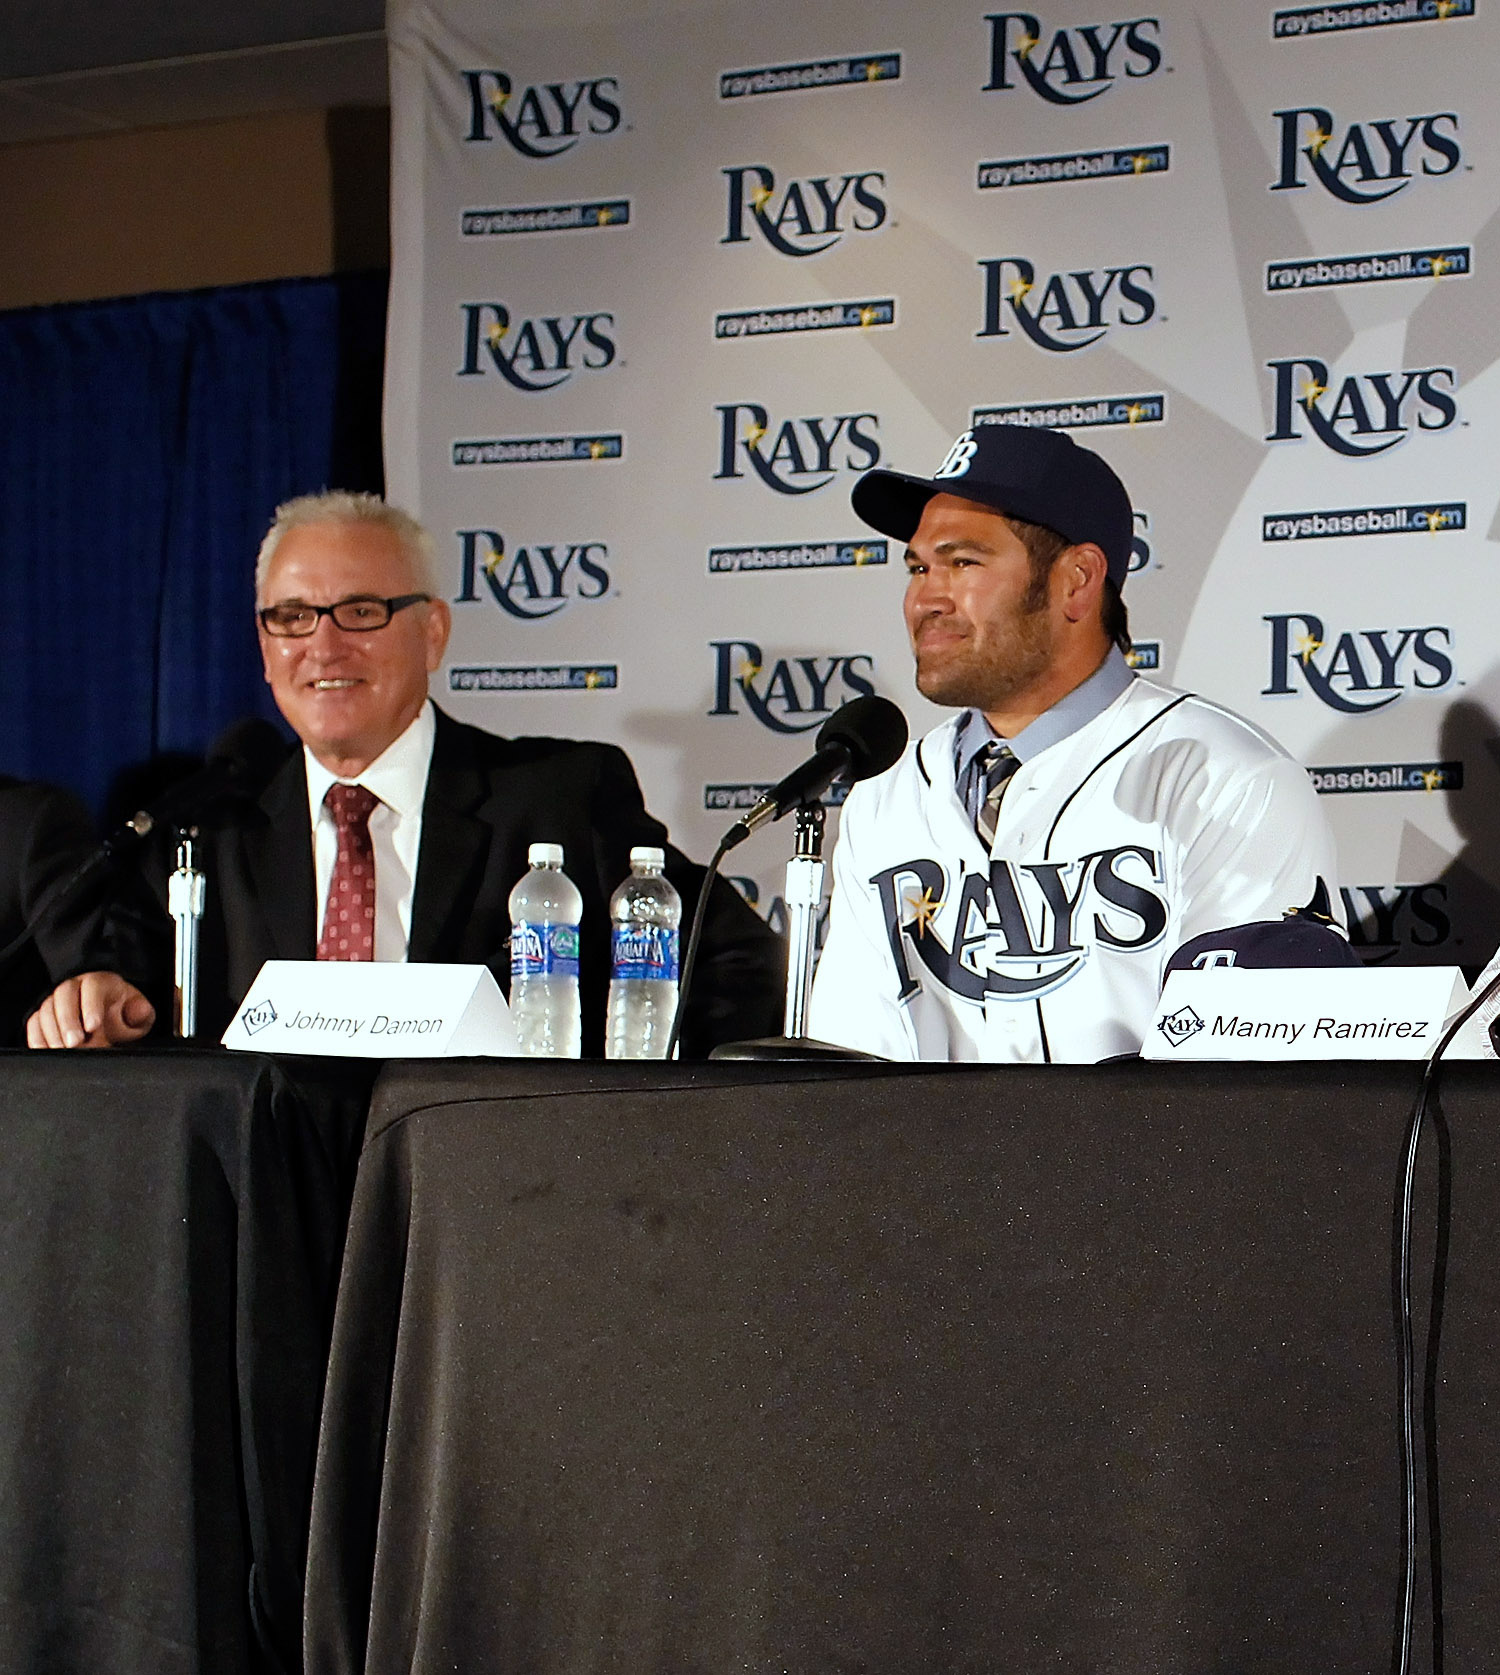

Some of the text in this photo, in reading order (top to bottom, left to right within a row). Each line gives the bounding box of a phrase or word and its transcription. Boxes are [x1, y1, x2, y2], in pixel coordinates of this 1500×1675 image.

[982, 13, 1161, 105] RAYS
[461, 70, 621, 158] RAYS
[1270, 108, 1460, 204] RAYS
[720, 166, 886, 257] RAYS
[458, 303, 616, 391] RAYS
[976, 258, 1155, 352] RAYS
[713, 404, 881, 495] RAYS
[1266, 359, 1456, 456] RAYS
[454, 530, 610, 619] RAYS
[707, 641, 875, 734] RAYS
[1261, 614, 1452, 714] RAYS
[869, 845, 1169, 1003] RAYS
[285, 1011, 366, 1038] Johnny
[370, 1015, 443, 1035] Damon
[1157, 1015, 1205, 1036] RAYS
[1211, 1015, 1429, 1044] Manny Ramirez
